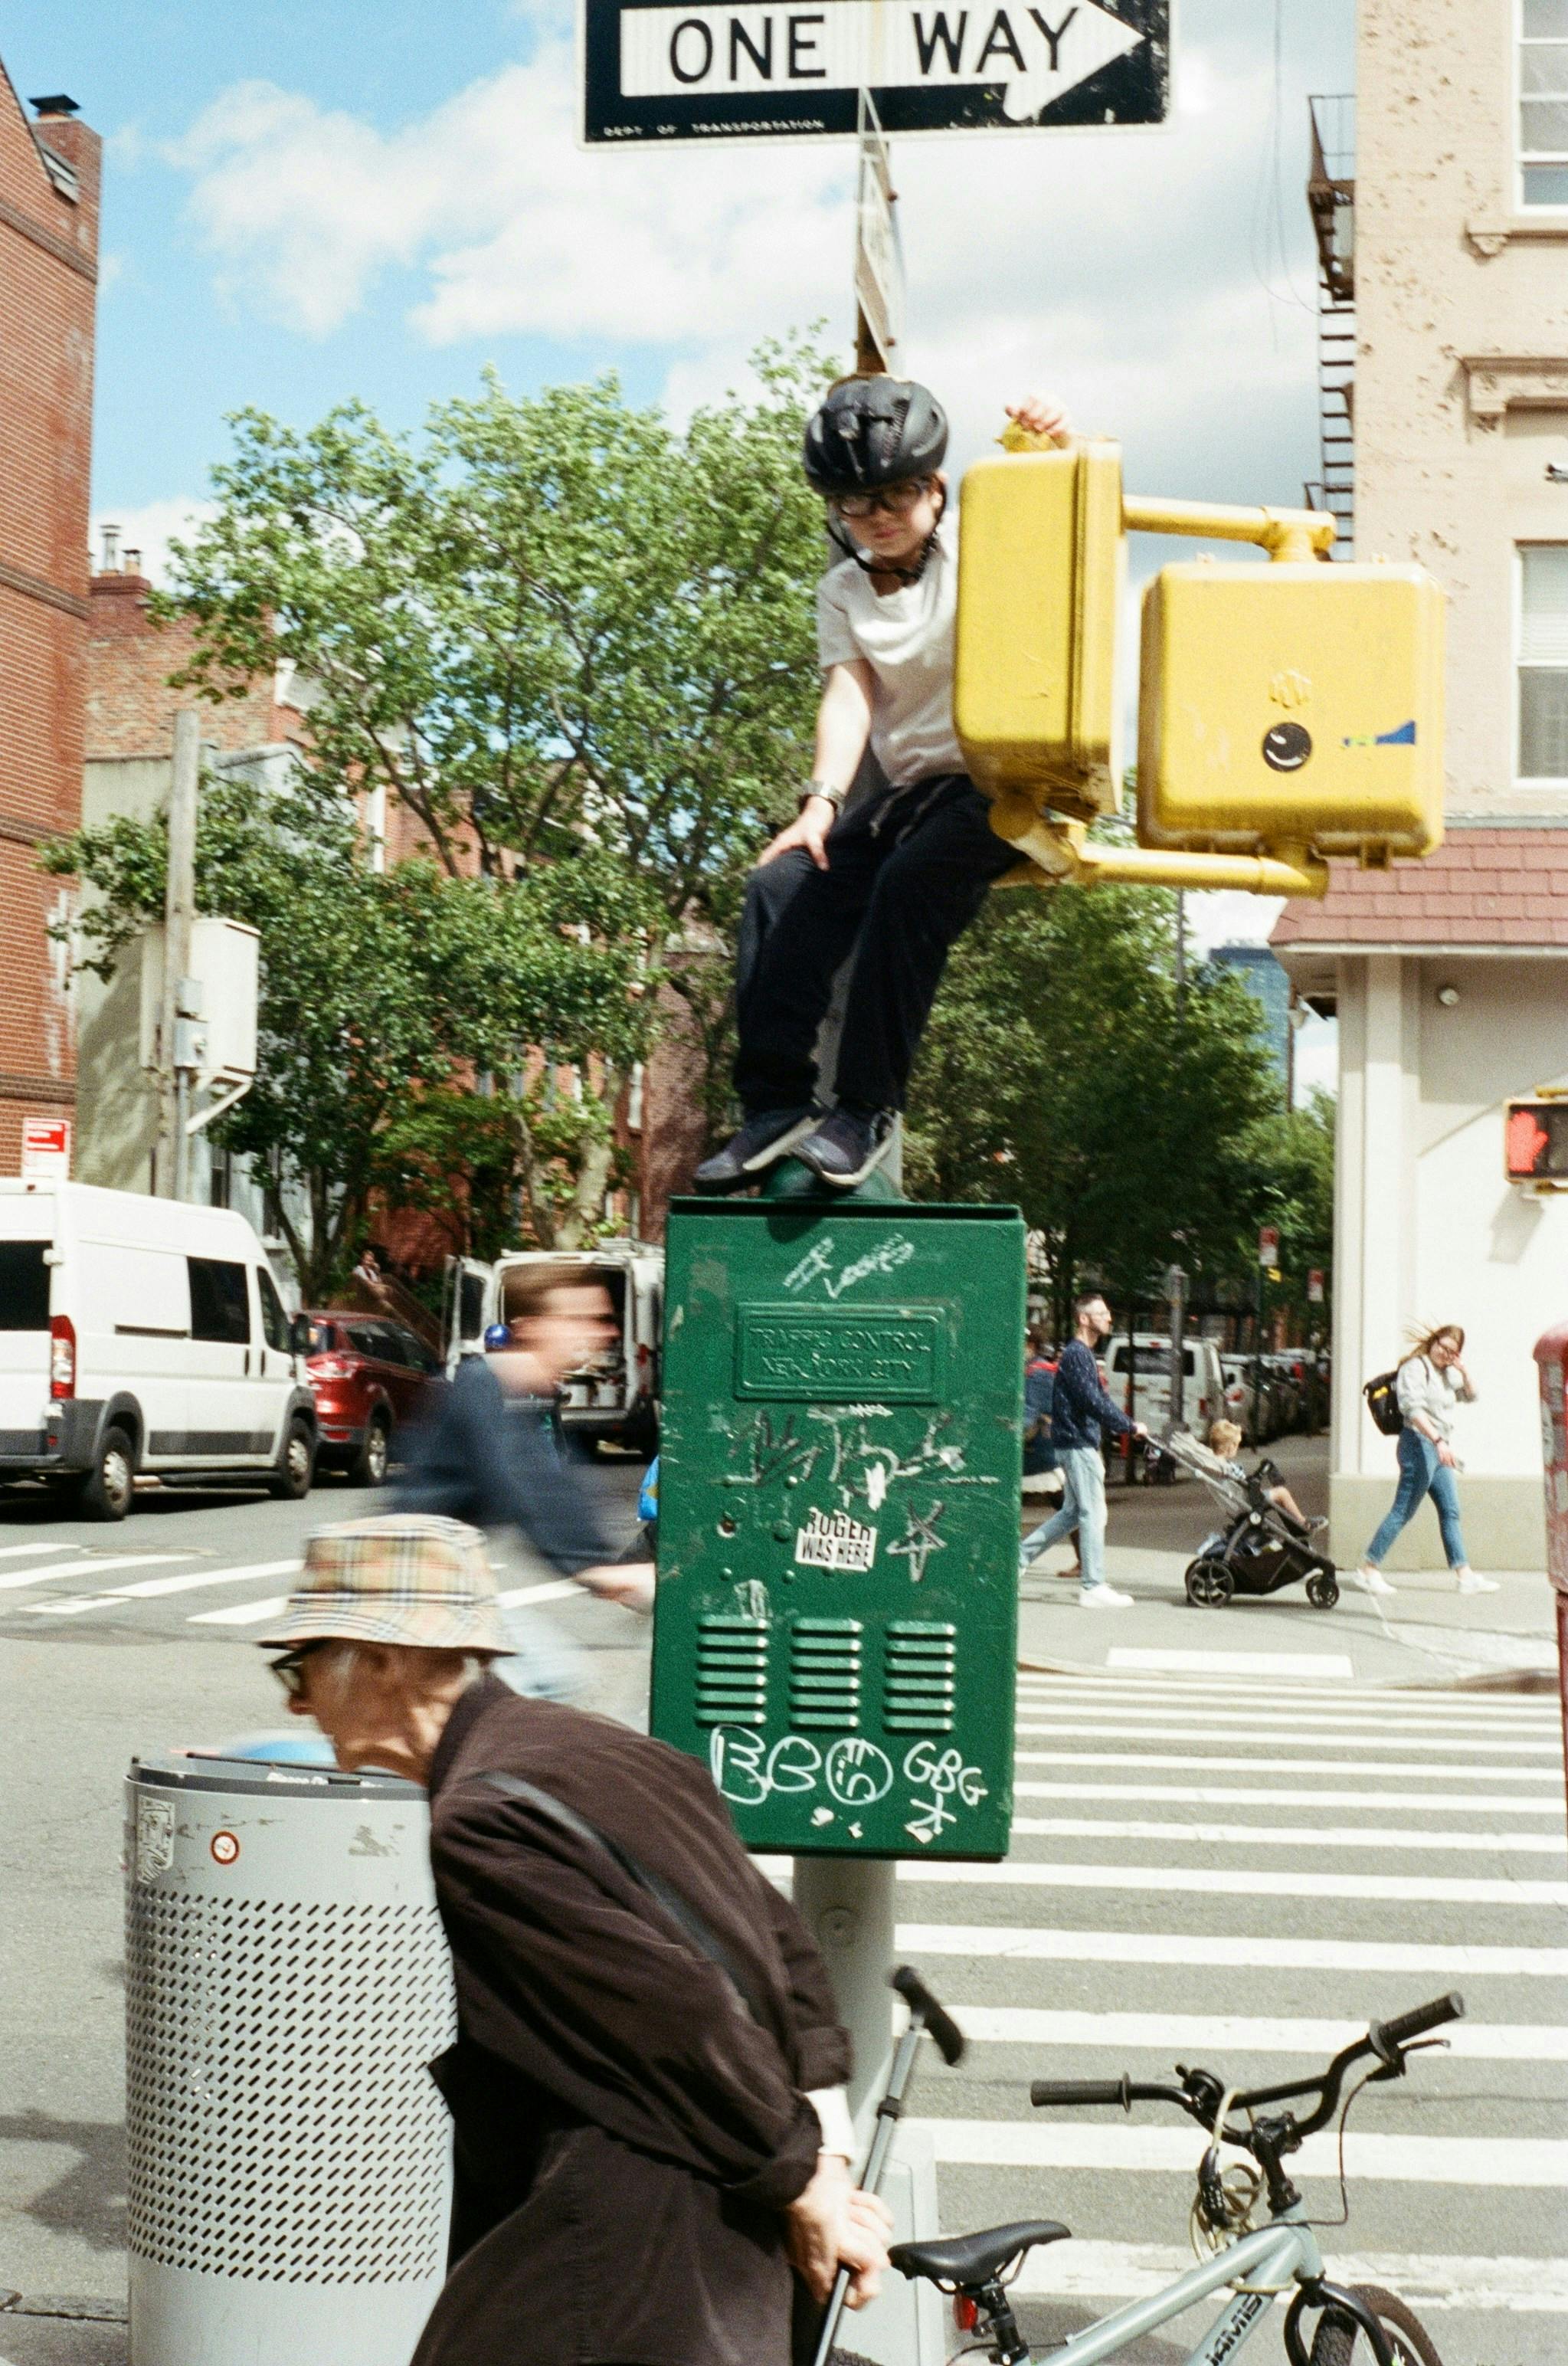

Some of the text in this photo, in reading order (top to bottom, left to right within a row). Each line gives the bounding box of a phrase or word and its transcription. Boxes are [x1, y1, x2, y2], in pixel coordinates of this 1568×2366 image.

[669, 7, 1079, 84] ONE WAY
[836, 1541, 870, 1568] HERE
